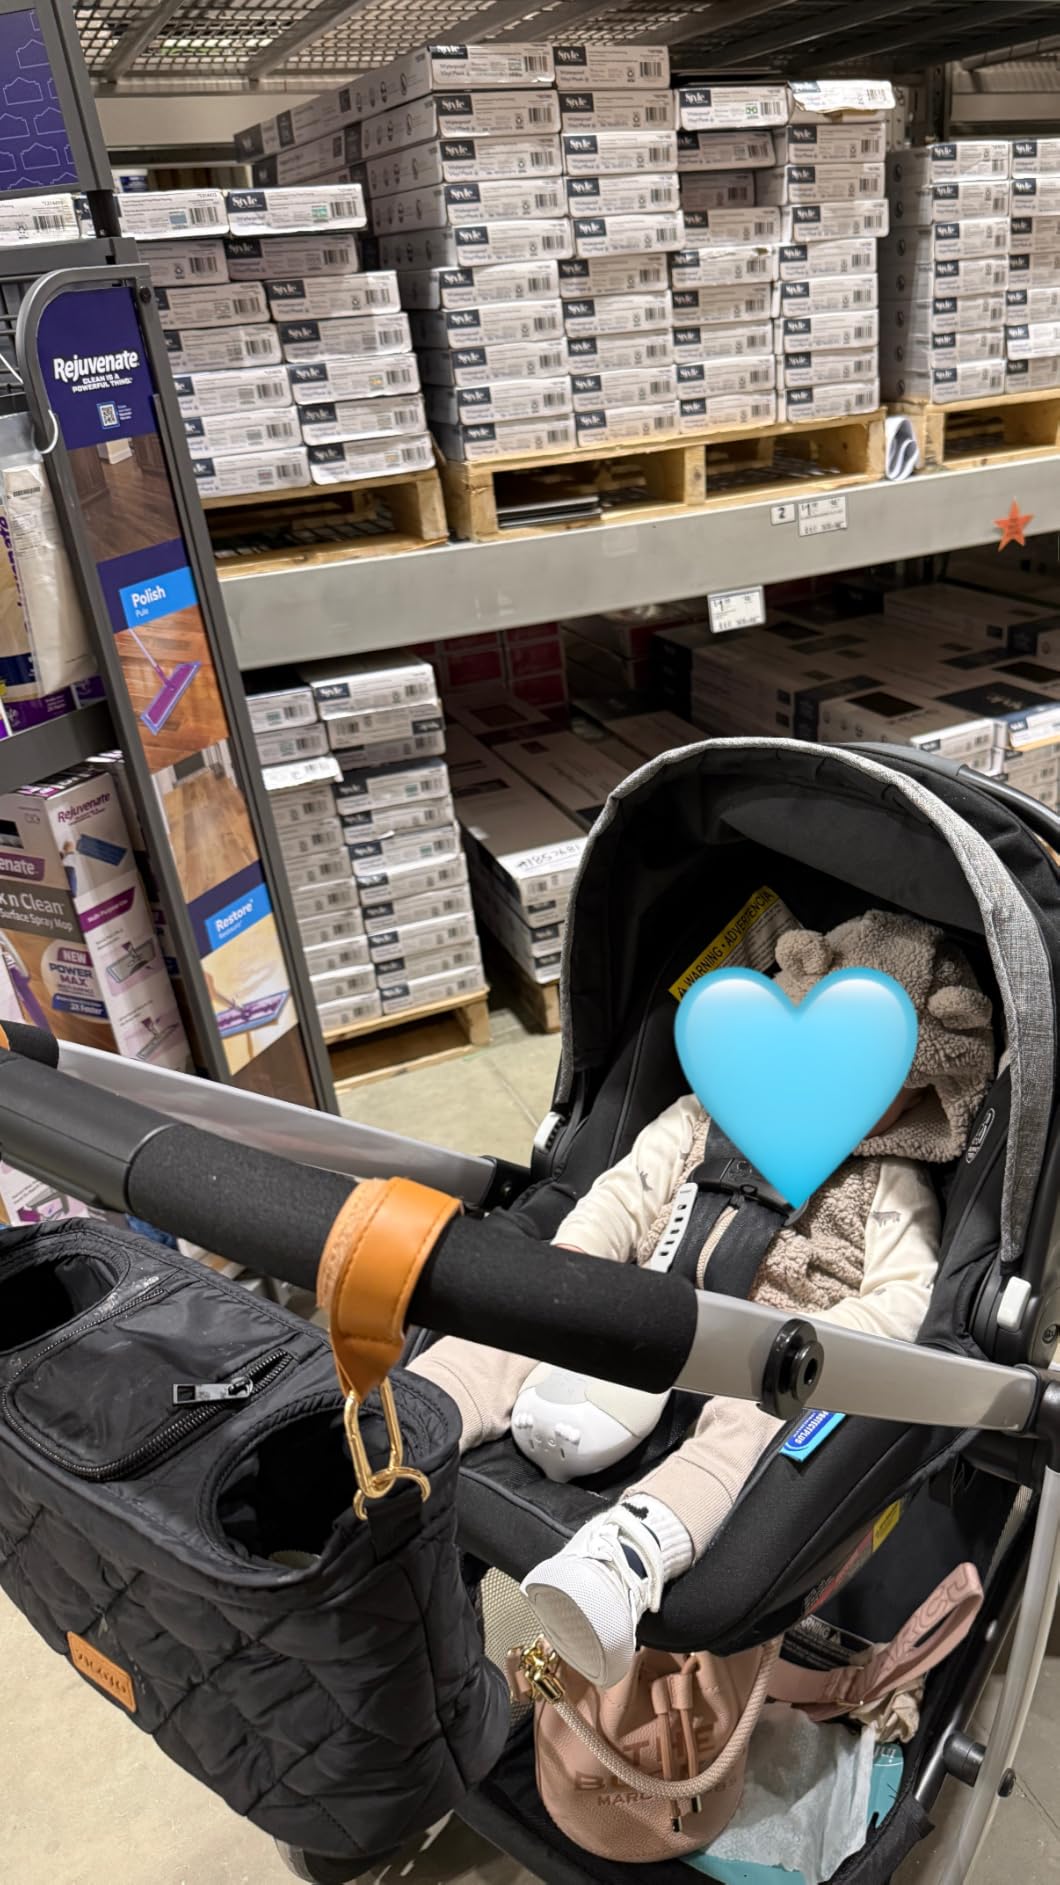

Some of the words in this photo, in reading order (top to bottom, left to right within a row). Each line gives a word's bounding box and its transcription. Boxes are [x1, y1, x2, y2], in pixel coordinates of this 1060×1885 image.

[53, 350, 138, 383] Rejuvenate
[72, 381, 110, 393] POWERFUL
[82, 375, 105, 385] CLEAN
[778, 507, 785, 519] 2
[131, 584, 166, 608] Polish
[58, 793, 110, 823] Rejuvenate
[7, 894, 19, 907] n
[20, 893, 64, 915] Clean
[30, 913, 54, 929] Spray
[54, 918, 73, 932] Mop
[215, 902, 253, 932] Restore
[684, 946, 724, 986] WARNING
[723, 890, 775, 948] ADVERTENCIA
[62, 949, 86, 964] NEW
[49, 962, 92, 978] POWER
[60, 974, 88, 987] MAX
[801, 1617, 831, 1638] RNING
